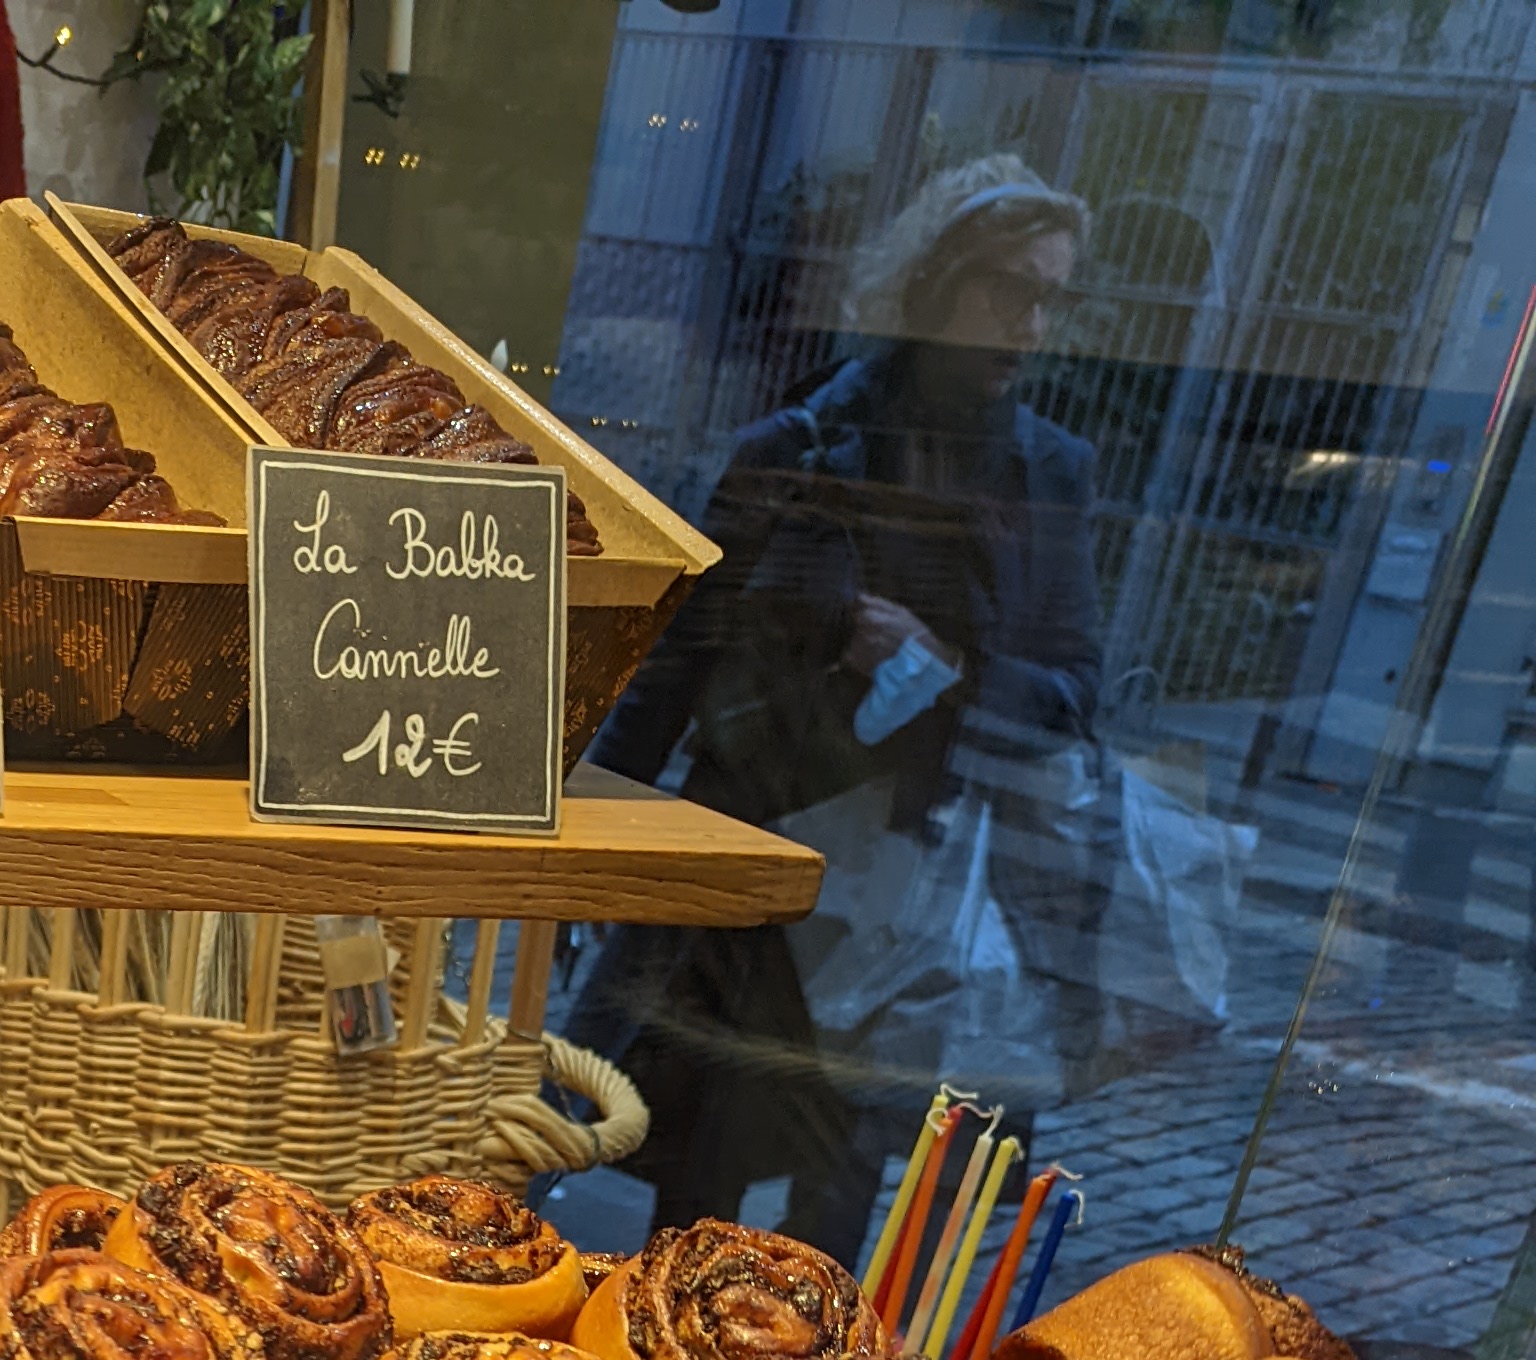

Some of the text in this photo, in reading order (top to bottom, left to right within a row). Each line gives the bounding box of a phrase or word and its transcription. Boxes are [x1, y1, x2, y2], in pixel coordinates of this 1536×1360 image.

[293, 490, 536, 581] La Babka
[313, 598, 500, 680] Cannelle
[342, 709, 483, 778] 12€
